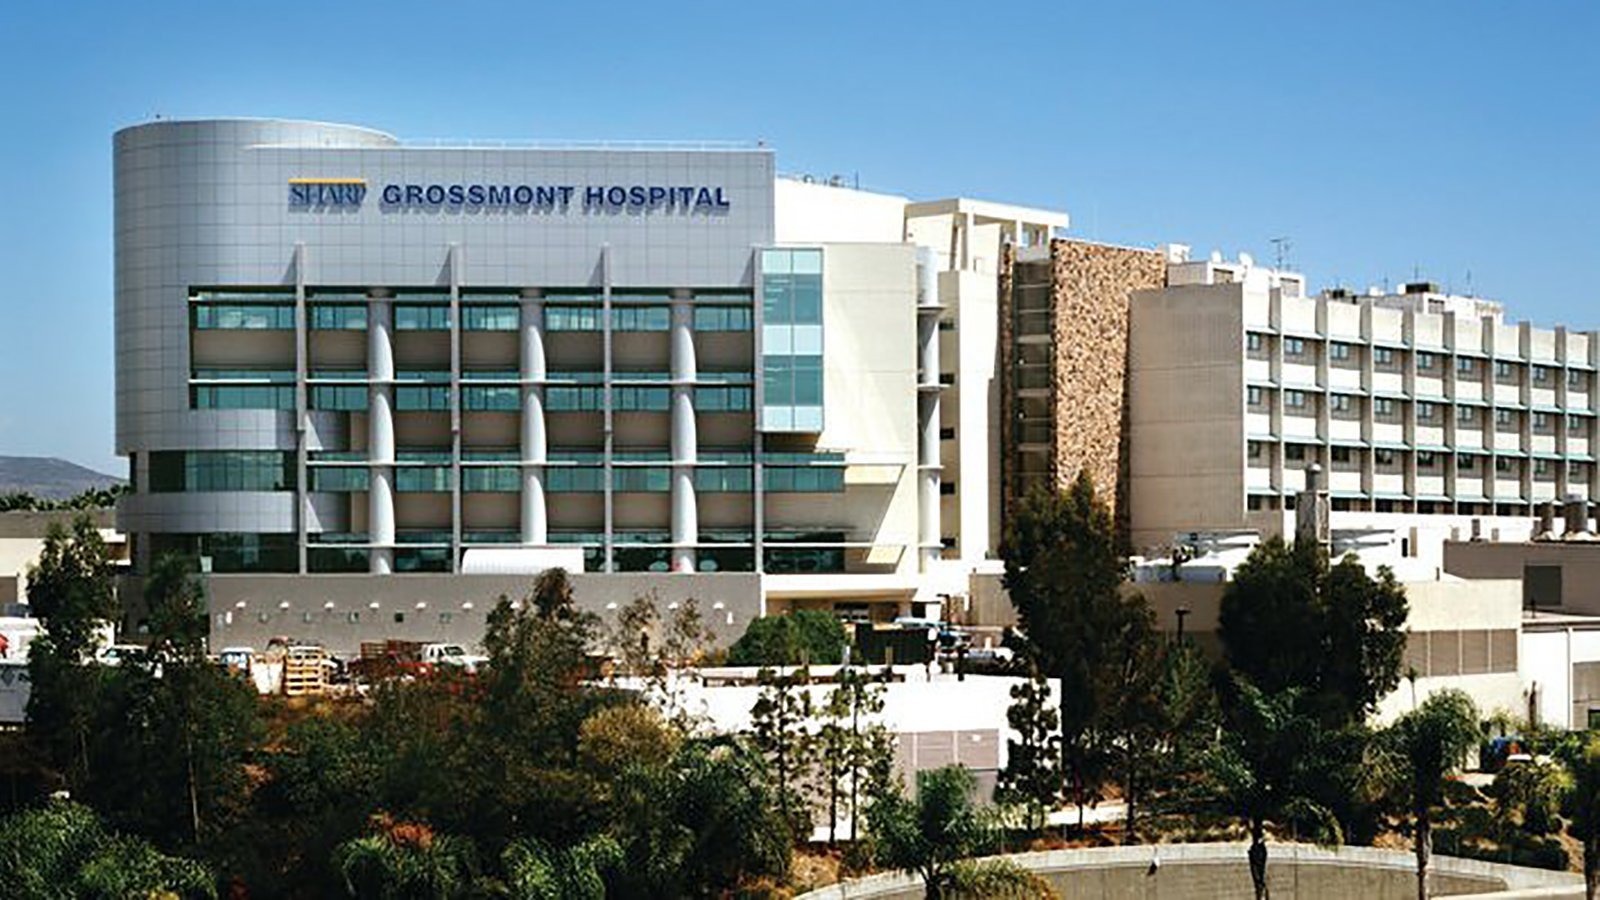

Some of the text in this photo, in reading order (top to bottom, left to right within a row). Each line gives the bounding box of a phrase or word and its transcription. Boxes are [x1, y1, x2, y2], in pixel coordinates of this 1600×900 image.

[290, 183, 730, 207] SHARP GROSSMONT HOSPITAL
